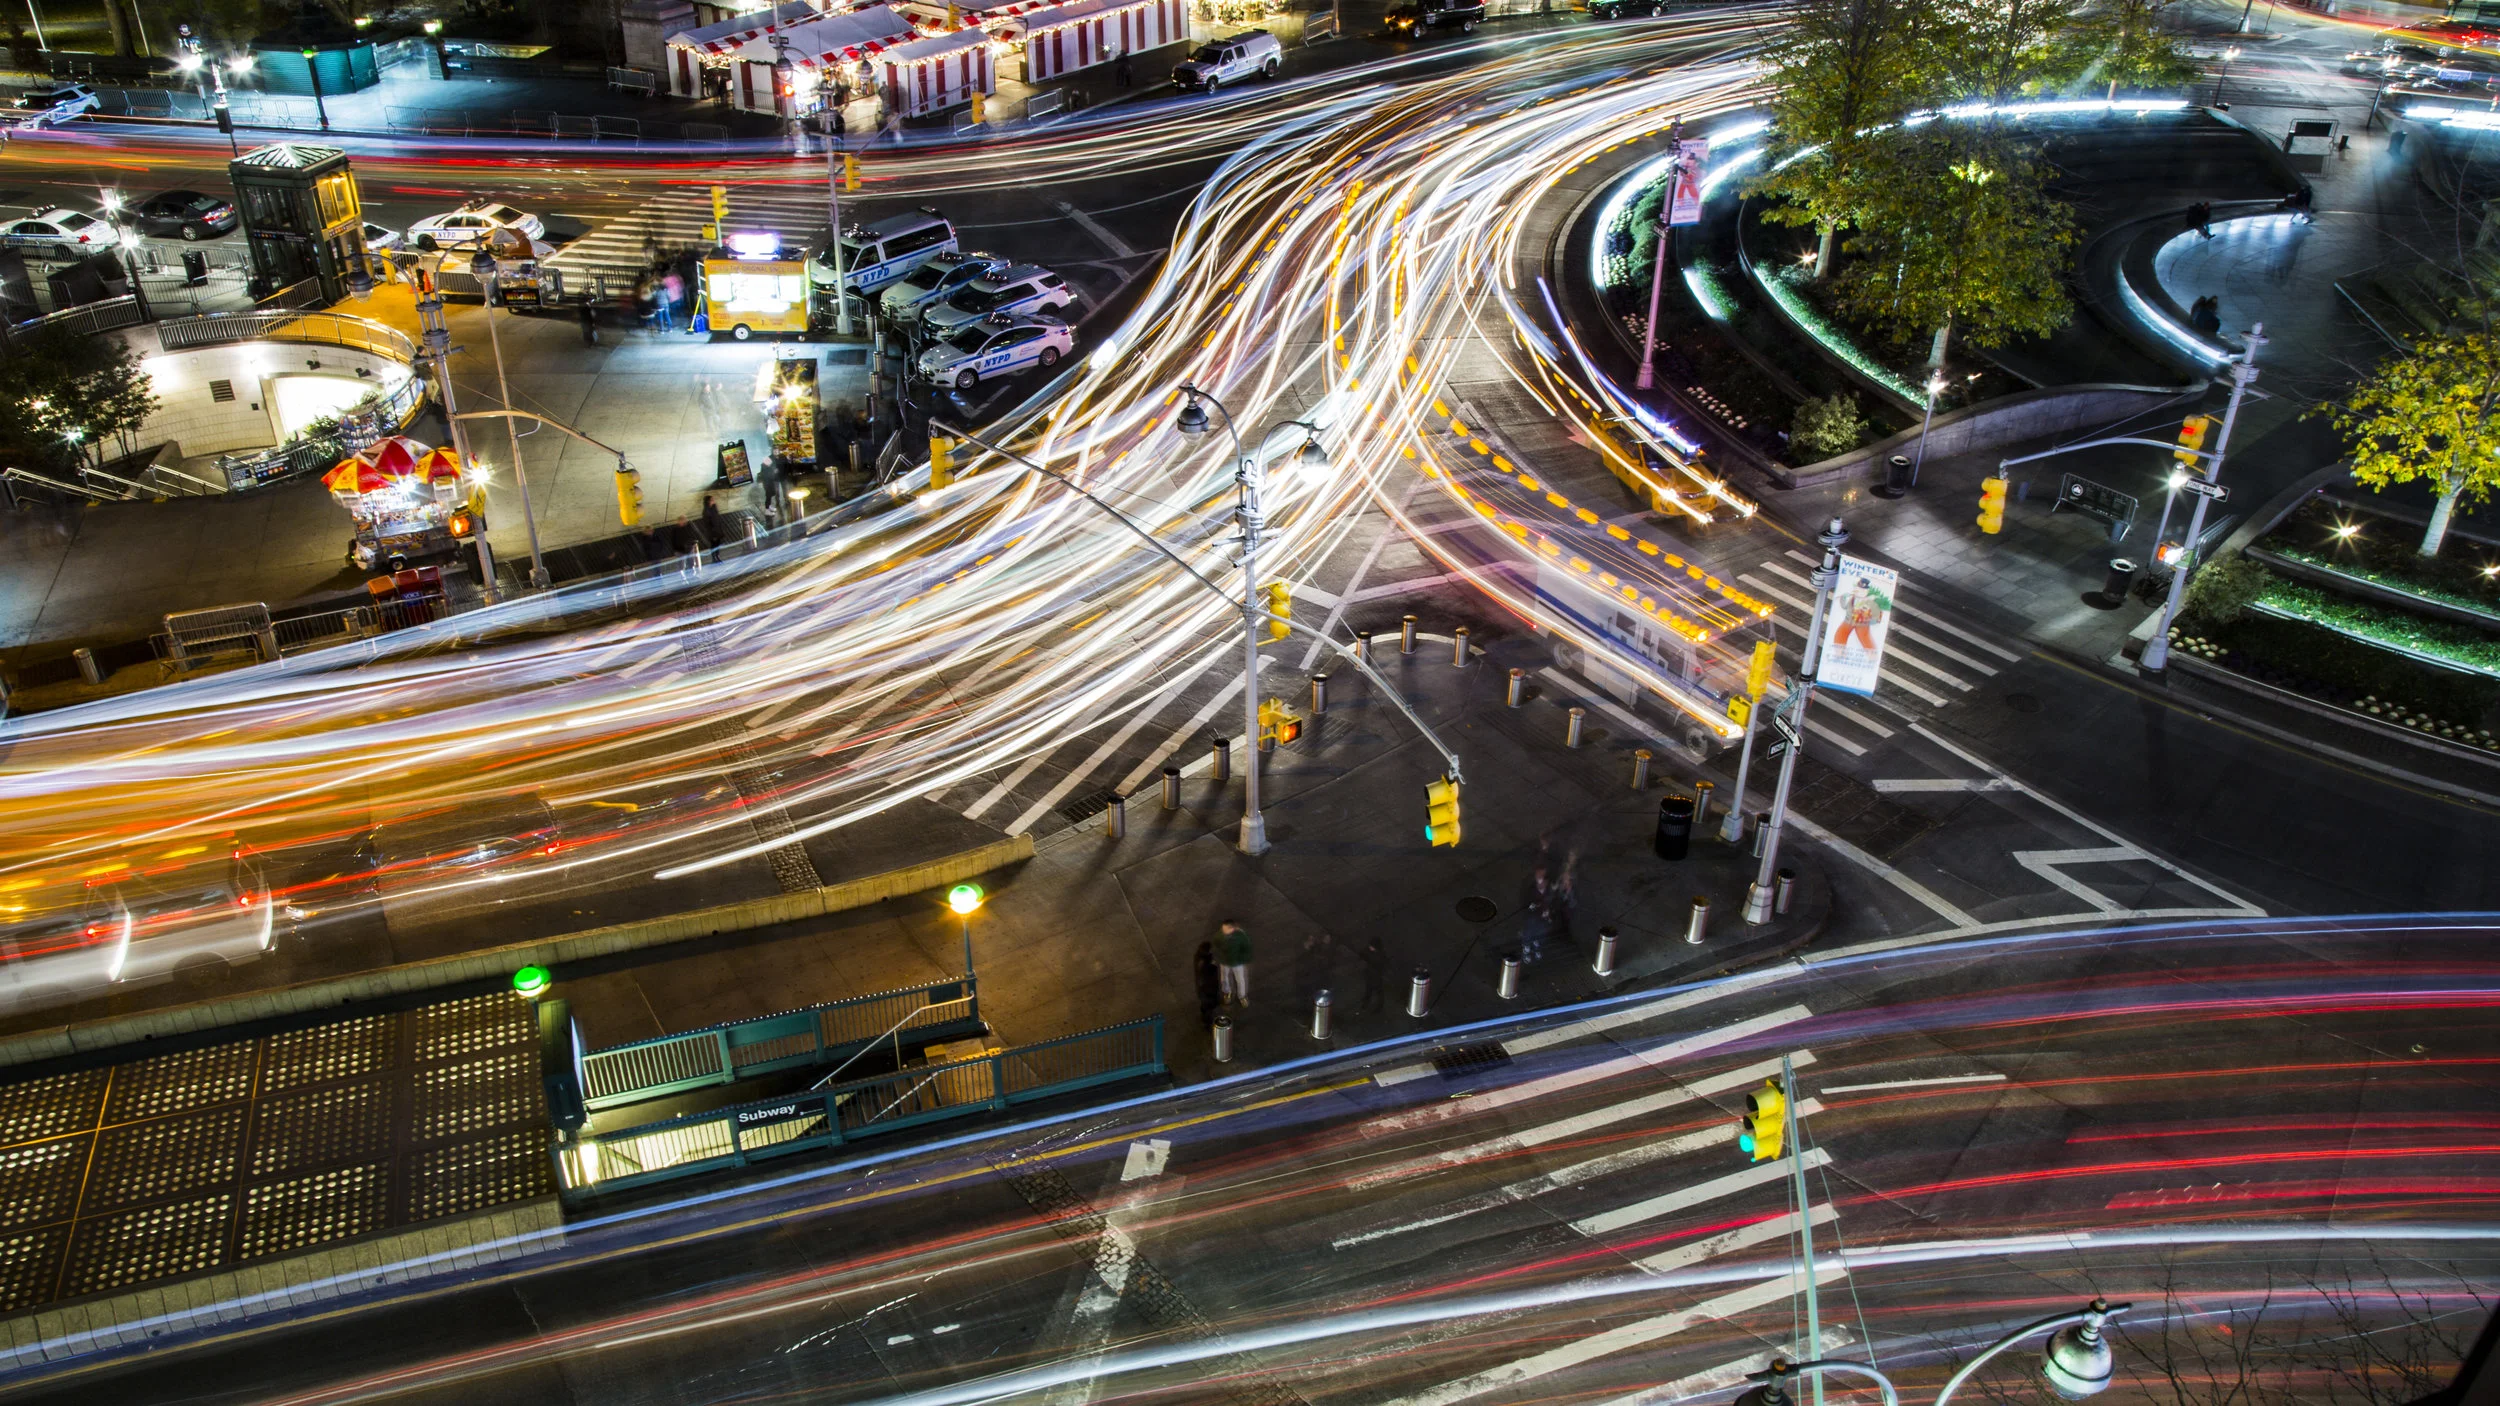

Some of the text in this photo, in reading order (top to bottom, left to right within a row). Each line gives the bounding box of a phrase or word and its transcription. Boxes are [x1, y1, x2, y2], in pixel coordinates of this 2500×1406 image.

[862, 267, 890, 283] NYPD
[984, 353, 1011, 367] NYPD
[2188, 481, 2215, 494] ONE WAY
[1841, 567, 1863, 577] EVE
[1843, 559, 1895, 580] WINTER'S
[403, 591, 420, 599] VOICE
[738, 1104, 797, 1123] Subway
